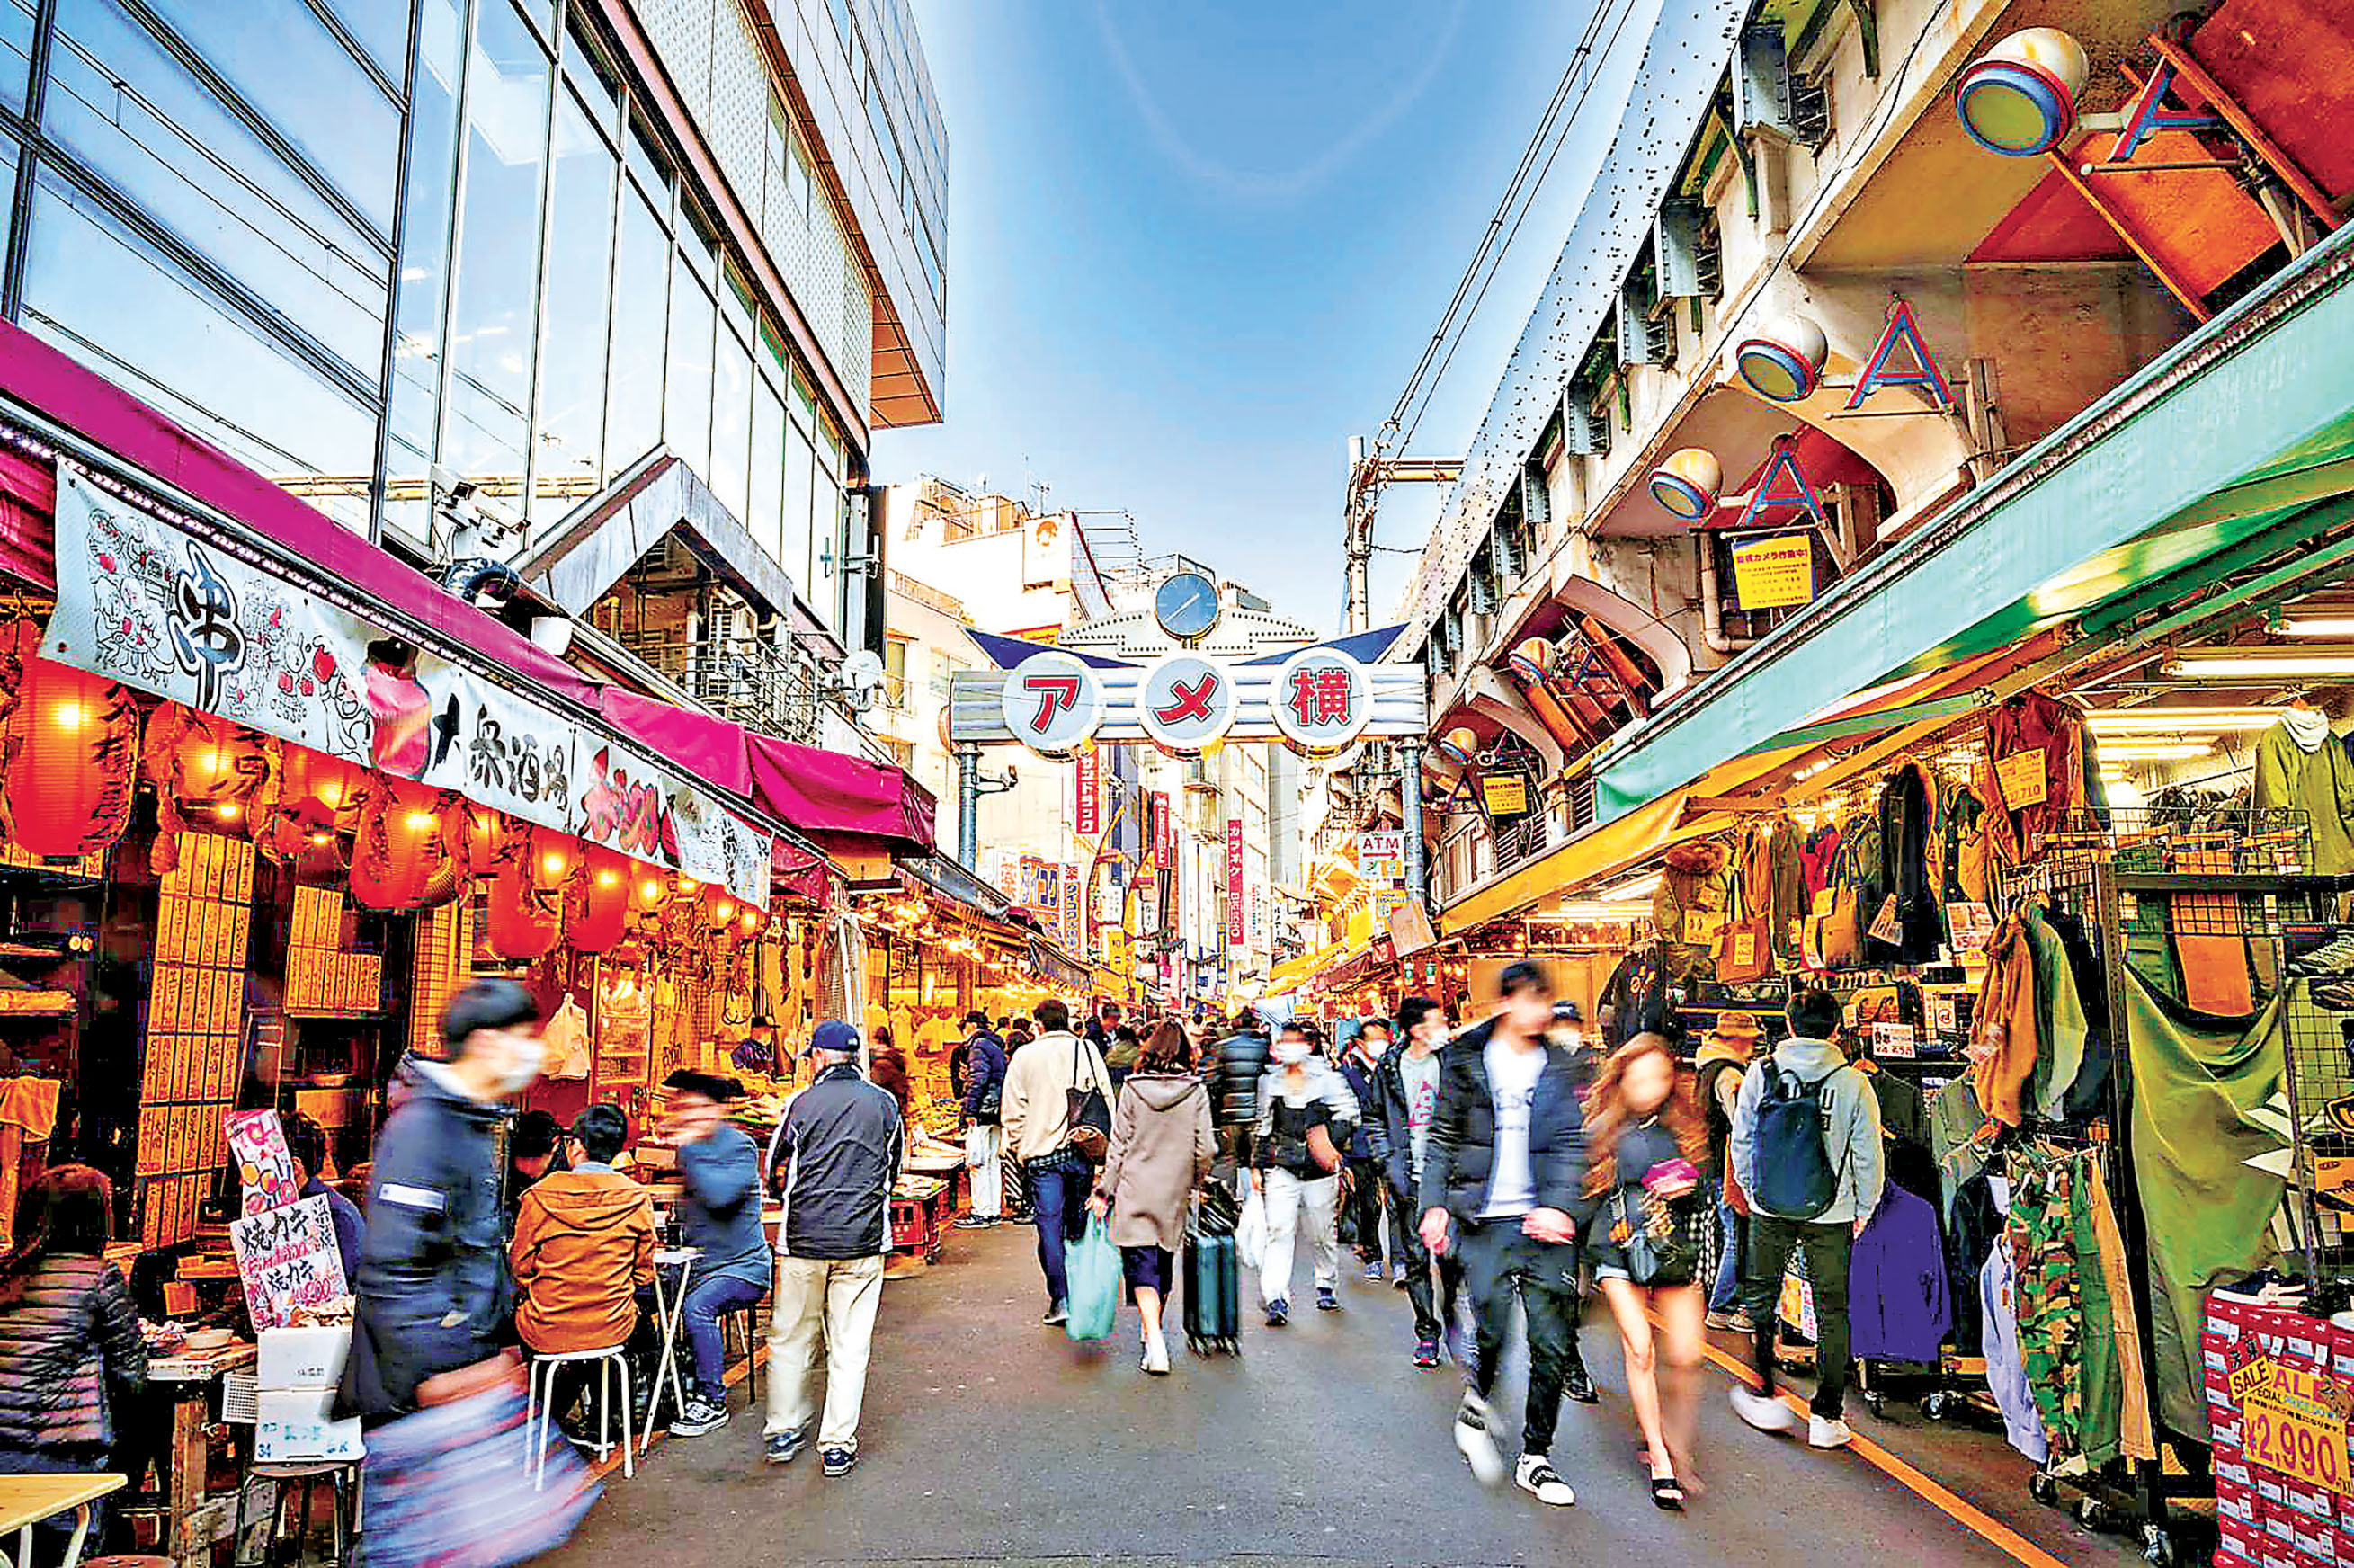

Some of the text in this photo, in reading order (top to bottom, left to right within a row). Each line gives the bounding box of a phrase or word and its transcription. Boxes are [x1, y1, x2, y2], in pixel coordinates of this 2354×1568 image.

[1023, 667, 1352, 734] アメ横
[1229, 825, 1242, 878] カラオケ
[1362, 837, 1399, 850] ATM
[2233, 1361, 2269, 1395] SALE
[2245, 1413, 2337, 1485] ¥2,990
